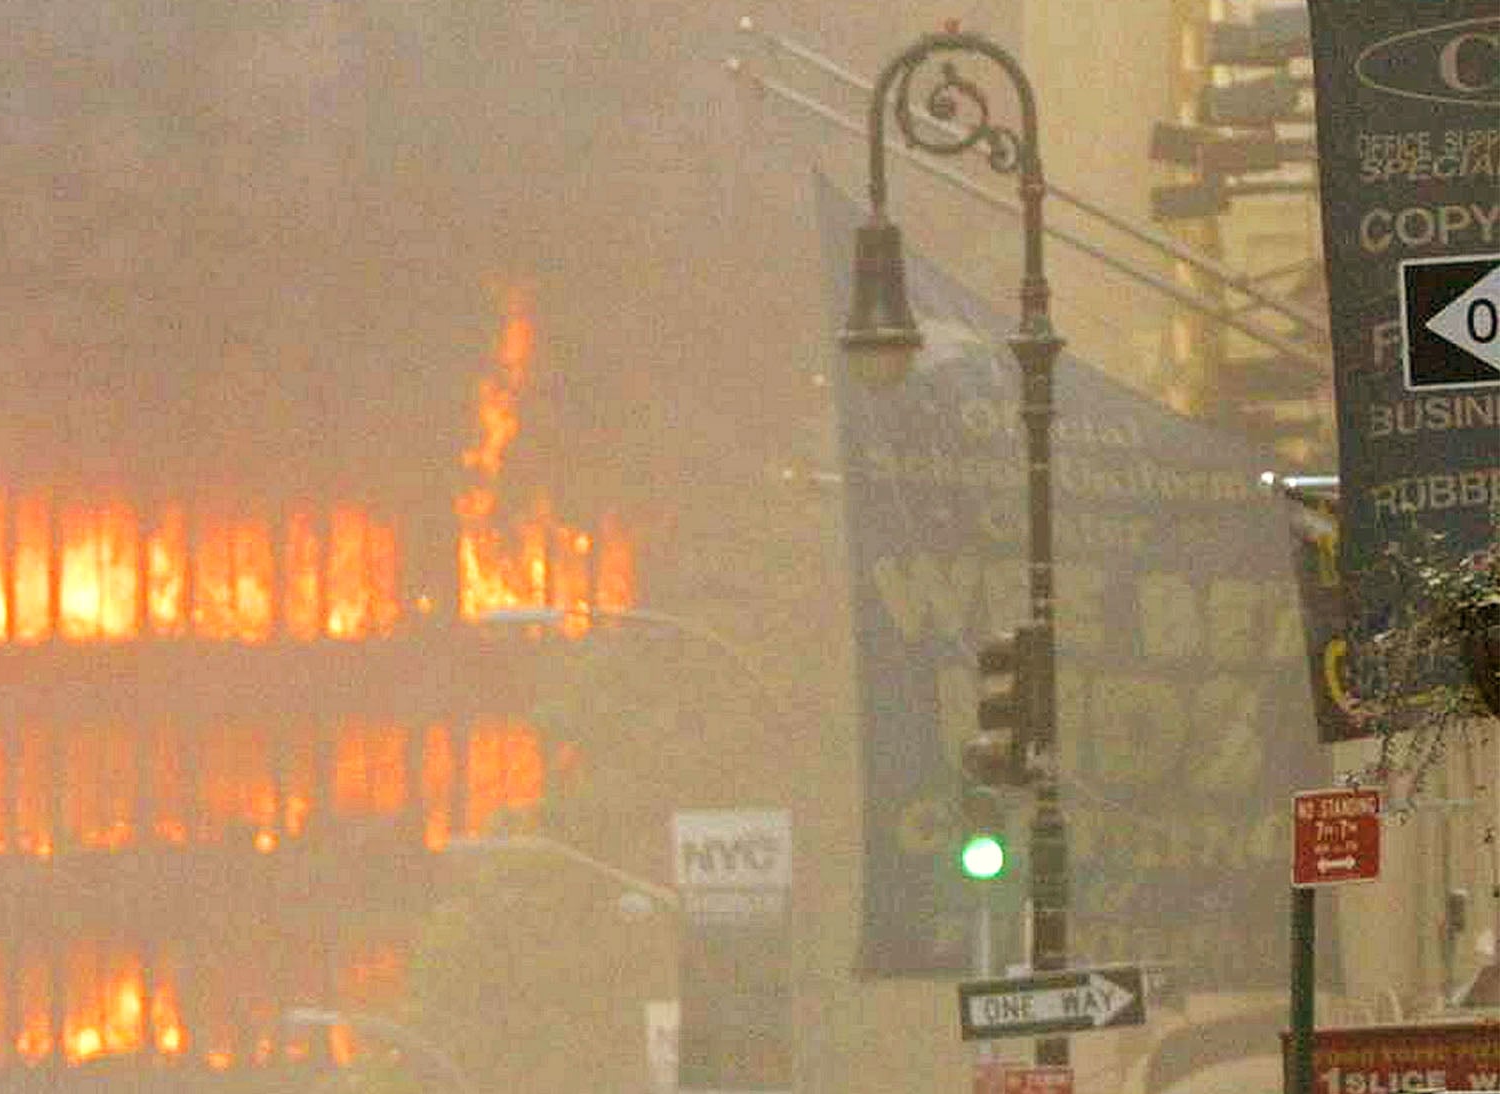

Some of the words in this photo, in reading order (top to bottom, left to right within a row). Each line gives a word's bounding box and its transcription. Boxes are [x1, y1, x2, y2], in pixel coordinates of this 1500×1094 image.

[1368, 394, 1500, 437] BUSIN
[985, 996, 1034, 1021] ONE
[1060, 988, 1112, 1014] WAY
